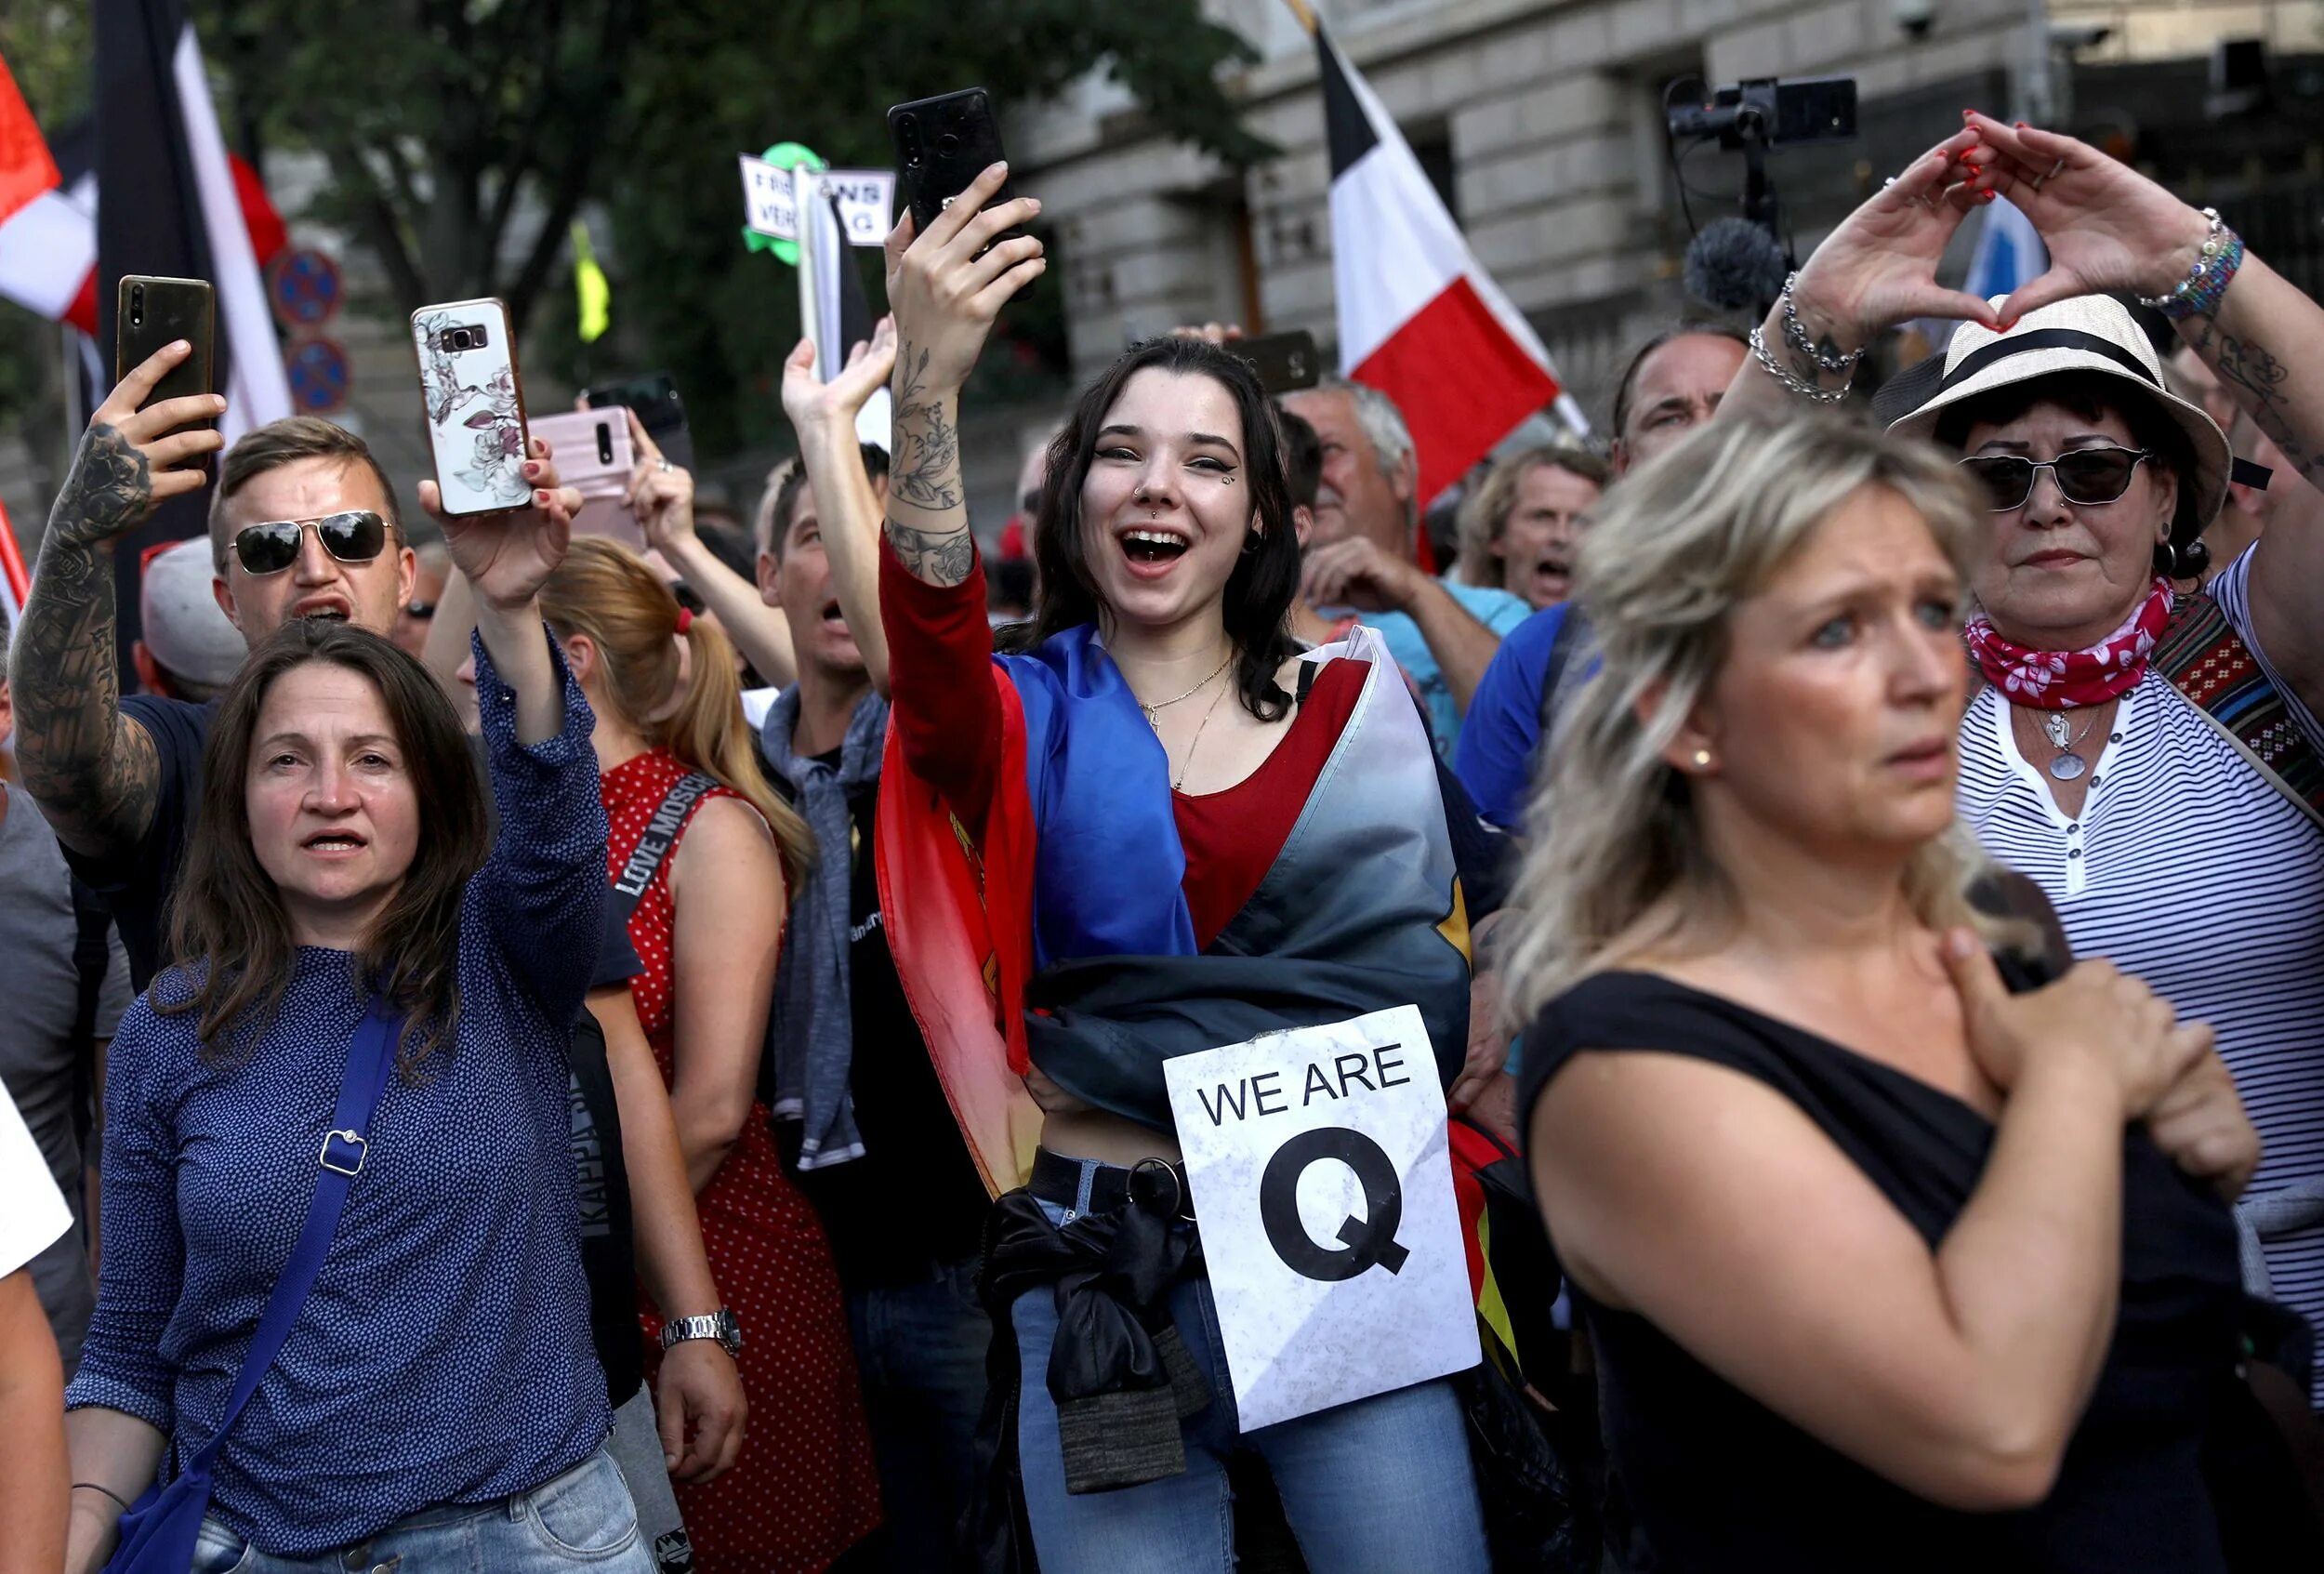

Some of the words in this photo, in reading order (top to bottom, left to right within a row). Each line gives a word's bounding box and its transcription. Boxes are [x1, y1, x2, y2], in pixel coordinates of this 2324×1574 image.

[614, 838, 667, 896] LOVE
[1197, 1071, 1289, 1127] WE
[1302, 1043, 1410, 1107] ARE
[1260, 1127, 1410, 1280] Q
